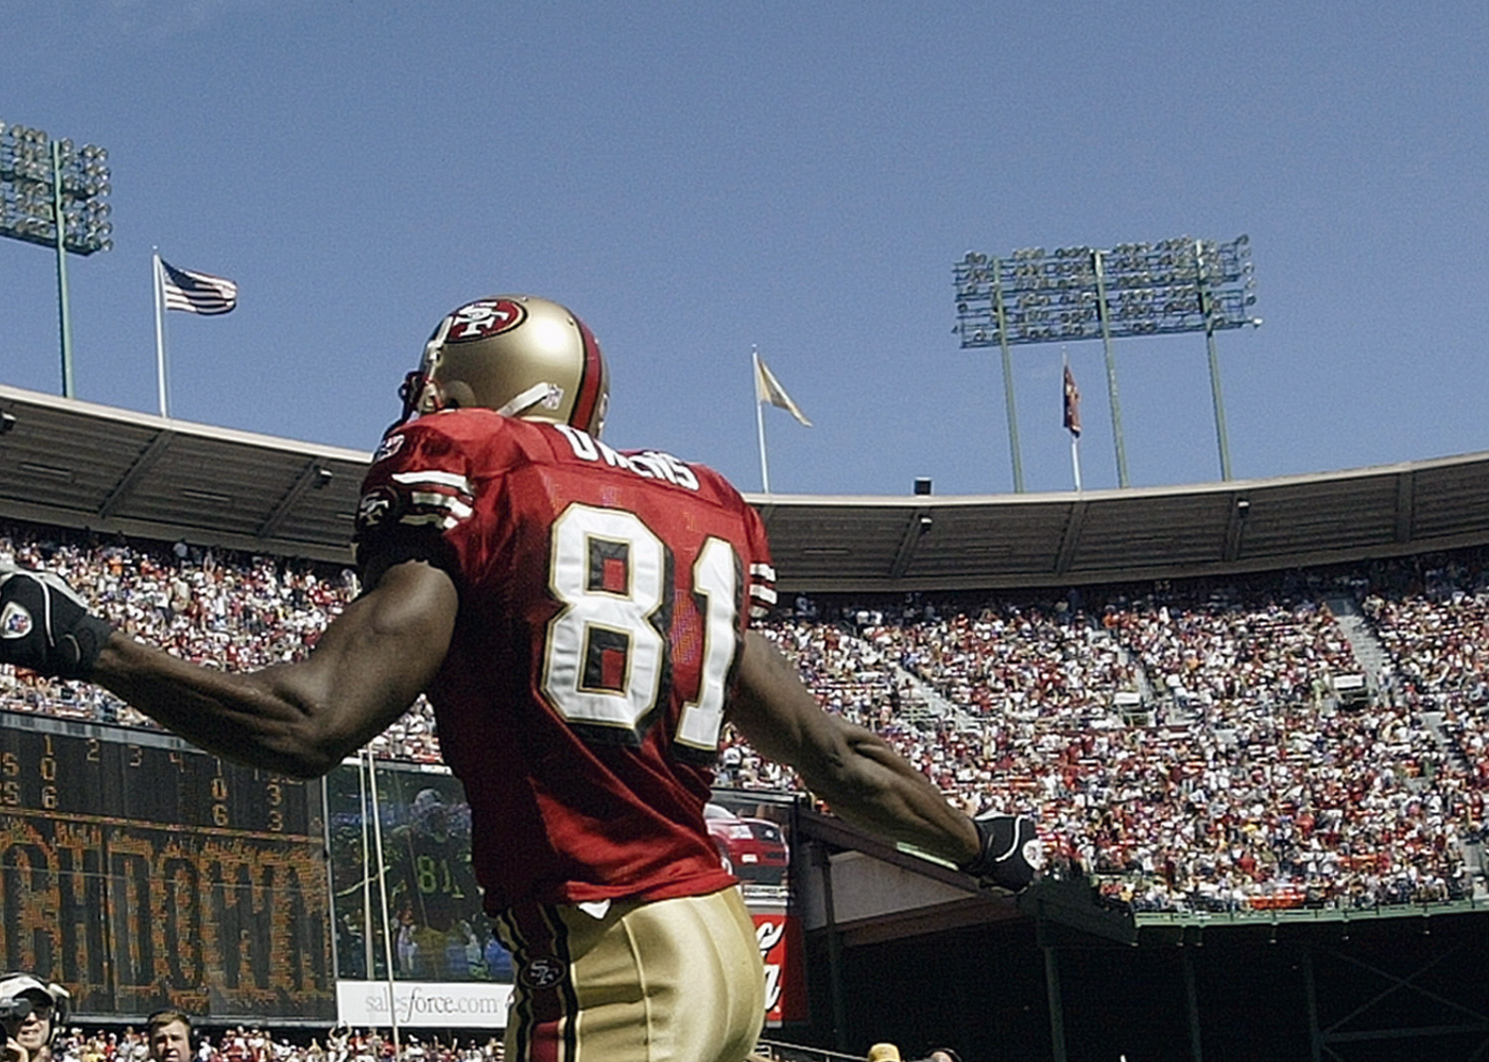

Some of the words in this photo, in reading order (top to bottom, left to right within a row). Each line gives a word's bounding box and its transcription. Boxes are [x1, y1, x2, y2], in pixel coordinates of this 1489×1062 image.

[543, 502, 740, 752] 81
[86, 738, 100, 762] 2
[40, 757, 56, 781] 0
[266, 783, 281, 806] 3
[42, 785, 58, 809] 6
[212, 803, 228, 827] 6
[267, 811, 283, 832] 3
[417, 855, 452, 894] 81
[365, 986, 498, 1023] salesforce.com
